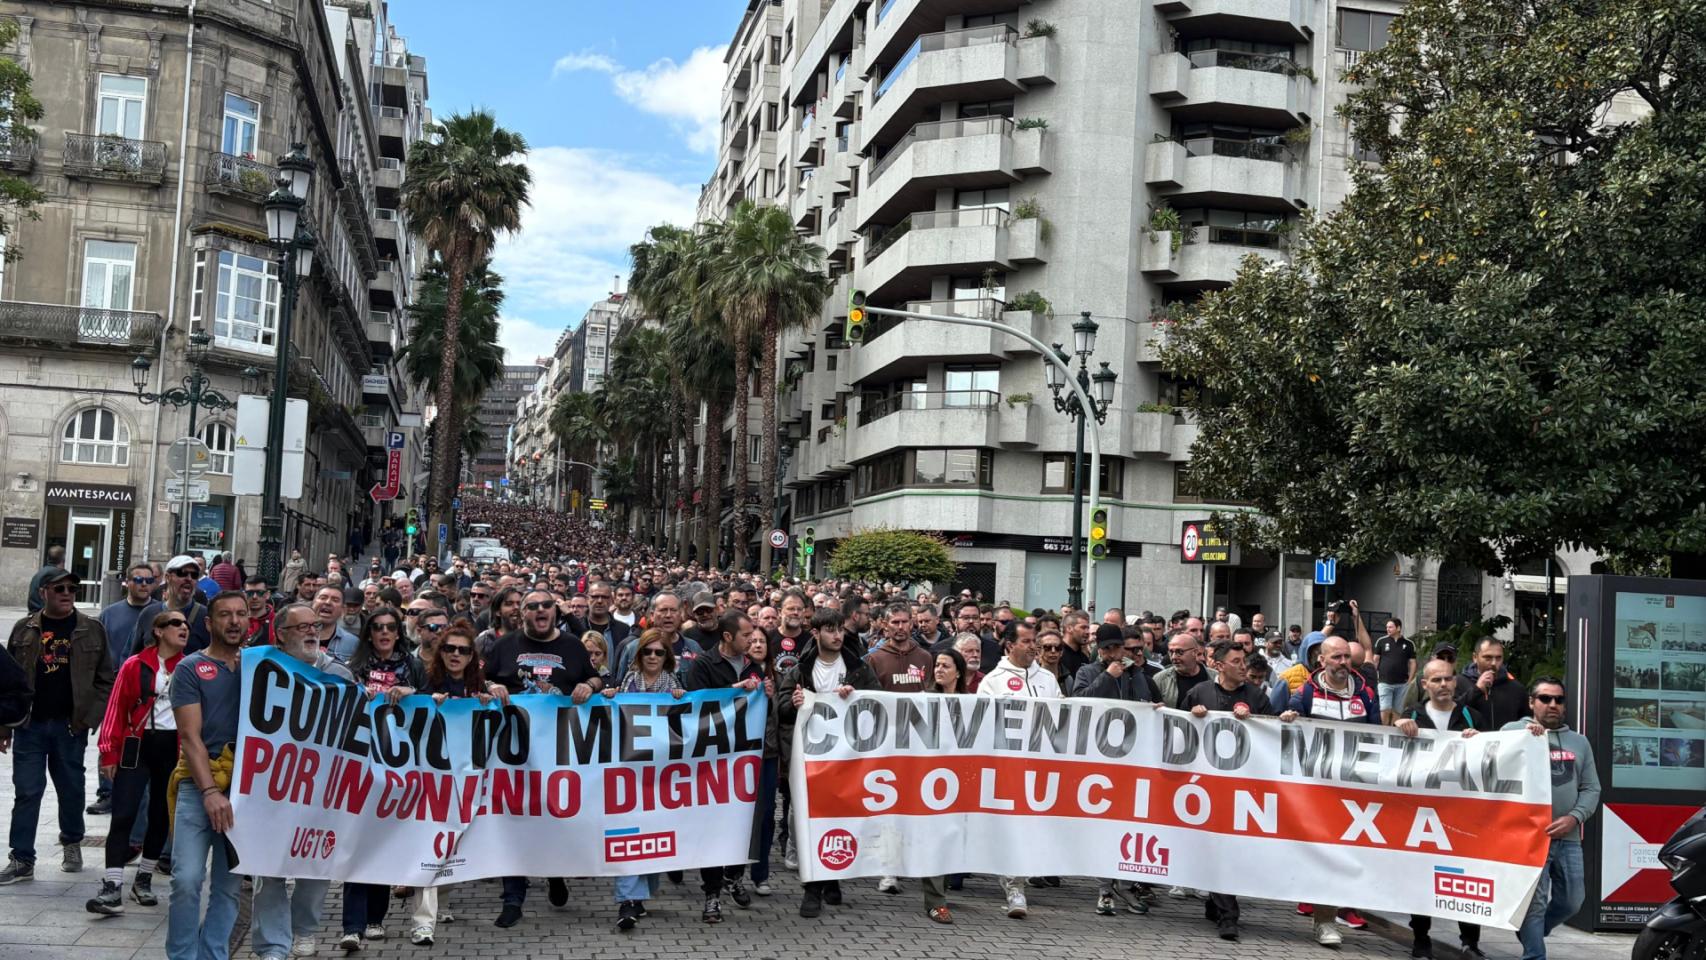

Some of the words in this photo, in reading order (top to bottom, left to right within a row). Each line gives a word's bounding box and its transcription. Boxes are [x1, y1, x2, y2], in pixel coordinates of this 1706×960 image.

[391, 433, 402, 446] P
[390, 451, 400, 487] GARAJE
[47, 487, 133, 502] AVANTESPACIA
[1186, 535, 1197, 551] 20
[369, 670, 387, 680] UGT
[250, 658, 452, 771] COMECIO
[472, 703, 531, 770] DO
[556, 696, 763, 767] METAL
[802, 696, 1137, 759] CONVENIO
[1162, 713, 1252, 771] DO
[1280, 723, 1523, 796] METAL
[239, 735, 321, 806] POR
[322, 754, 375, 815] UN
[604, 755, 762, 816] DIGNO
[862, 767, 1278, 834] SOLUCIÓN
[290, 826, 324, 859] UGT
[433, 831, 464, 860] CI
[610, 836, 672, 858] CCOO
[823, 836, 853, 853] UGT
[1120, 832, 1170, 867] CIG
[1119, 863, 1168, 876] INDUSTRIA
[1439, 877, 1490, 898] CCOO
[1435, 896, 1492, 917] industria
